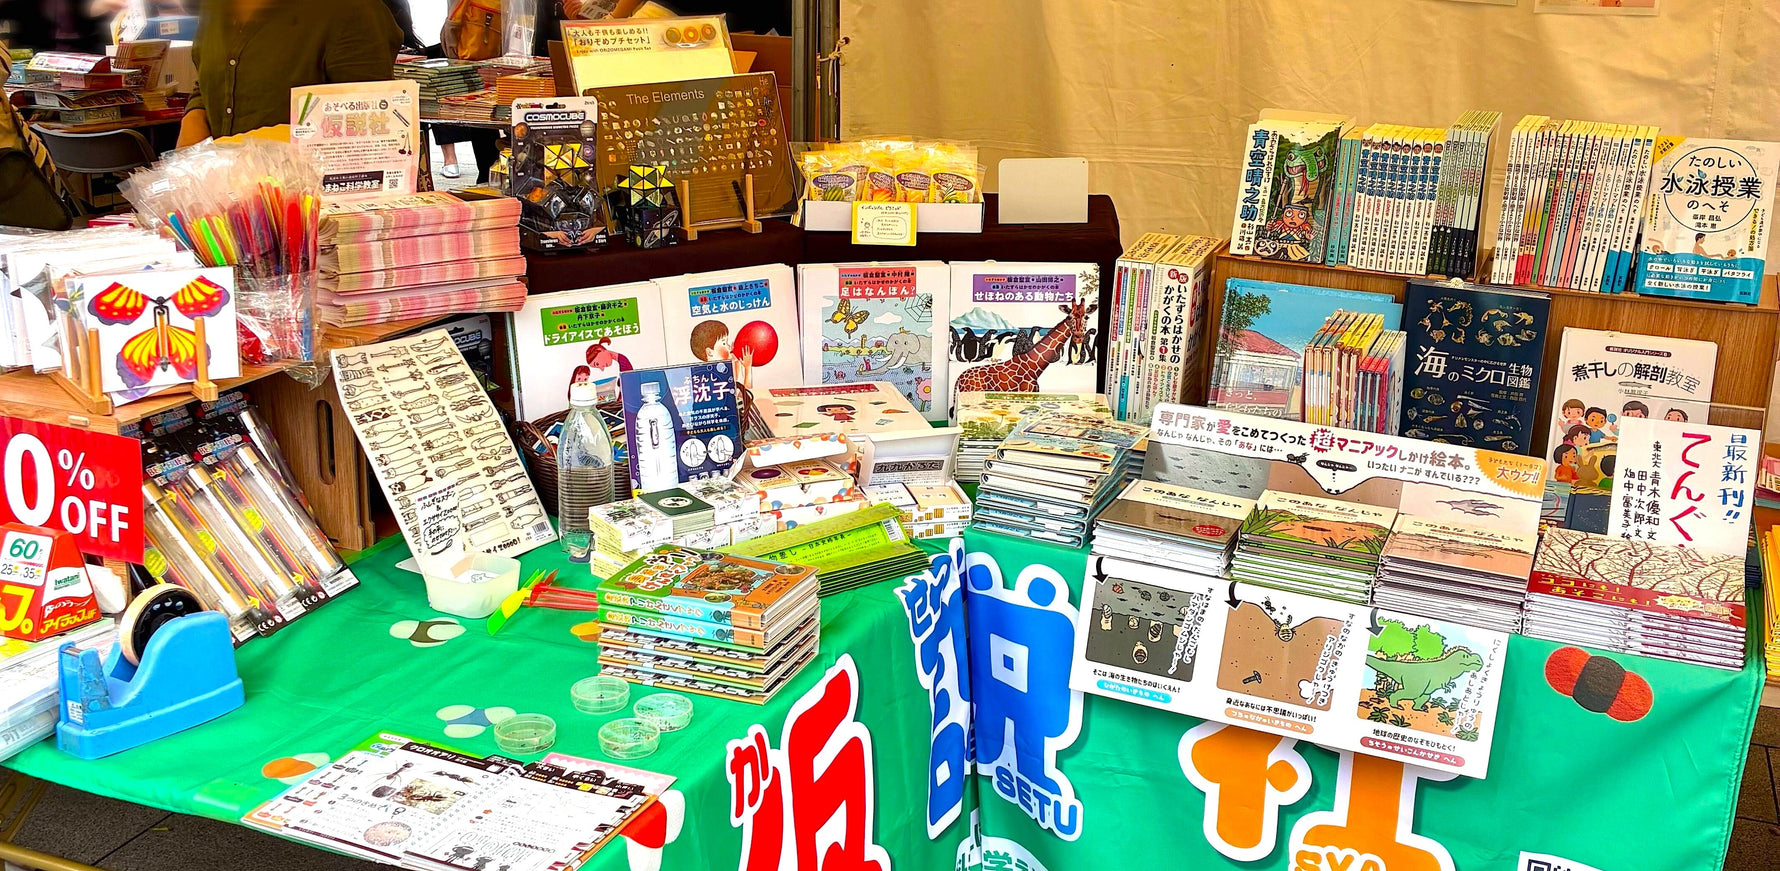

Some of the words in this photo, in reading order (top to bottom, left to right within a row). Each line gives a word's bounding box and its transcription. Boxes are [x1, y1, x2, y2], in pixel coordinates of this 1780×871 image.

[626, 92, 650, 105] The
[652, 88, 705, 103] Elements
[321, 112, 391, 138] 仮説社
[525, 111, 586, 122] COSMOCUBE
[1688, 155, 1742, 169] たのしい
[1240, 129, 1270, 222] 青空晴之助
[1660, 172, 1762, 199] 水泳授業
[1687, 200, 1729, 213] のへそ
[1723, 270, 1752, 278] バタフライ
[841, 286, 916, 297] 足はなんぼん?
[974, 291, 1074, 301] せぼねのある動物たち
[692, 297, 770, 316] 空気と水のじっけん
[1160, 285, 1175, 336] かがくの本
[544, 322, 640, 345] ドライアイスであそぼう
[1169, 284, 1188, 364] いたずらはかせの
[454, 331, 481, 344] OCUBE
[1414, 345, 1506, 385] 海のミクロ
[1508, 362, 1533, 377] 生物
[684, 373, 718, 385] ふちんし
[1506, 376, 1531, 389] 図鑑
[1571, 360, 1701, 395] 煮干しの解剖教室
[672, 381, 731, 405] 浮沈子
[1157, 428, 1183, 439] なんじゃ
[1218, 437, 1232, 447] その
[1651, 441, 1662, 468] 東北大
[876, 462, 939, 472] 九九かるた
[1367, 460, 1397, 472] いったい
[1399, 464, 1421, 476] ナニが
[1424, 468, 1481, 486] すんでいる???
[1496, 467, 1540, 484] 大ウケ!!
[1669, 432, 1712, 543] てんぐ
[1717, 433, 1748, 524] 最新刊!!
[1142, 486, 1190, 498] このあな
[1197, 495, 1243, 509] なんじゃ
[1277, 497, 1327, 509] このあな
[1334, 505, 1383, 518] なんじゃ
[60, 494, 129, 543] OFF
[1412, 521, 1466, 533] このあな
[1473, 530, 1524, 543] なんじゃ
[9, 538, 40, 561] 60
[54, 571, 81, 587] Iwatani
[1092, 668, 1107, 677] そこは
[1152, 692, 1165, 700] へん
[1226, 697, 1317, 723] 身近なあなには不思議がいっぱい!
[1231, 711, 1292, 729] つちのなかのいきもの
[1294, 723, 1308, 732] へん
[1372, 728, 1456, 752] 地球の歴史のなぞをひもとく!
[1368, 739, 1441, 761] ちそうのせいこんかせき
[1443, 755, 1457, 765] へん
[731, 731, 769, 818] か
[996, 766, 1077, 835] SETU
